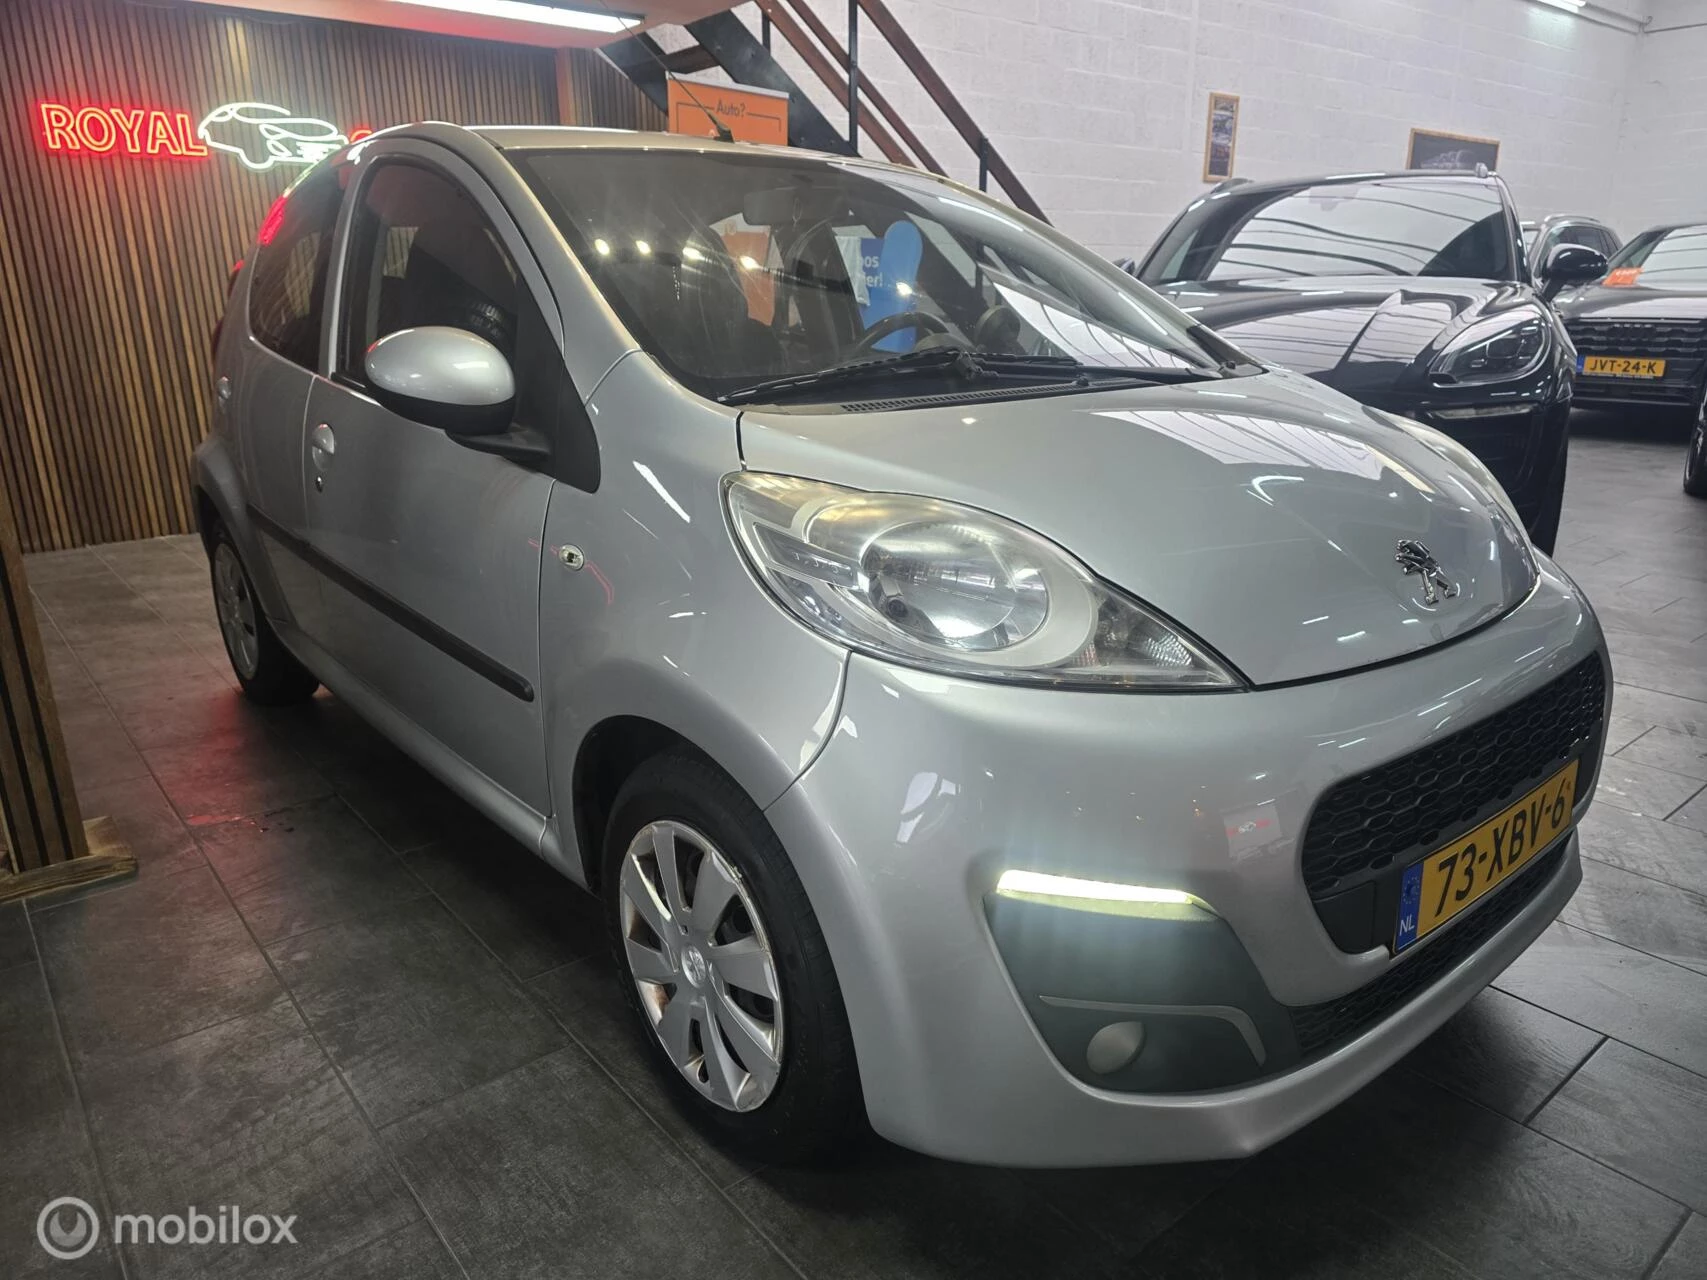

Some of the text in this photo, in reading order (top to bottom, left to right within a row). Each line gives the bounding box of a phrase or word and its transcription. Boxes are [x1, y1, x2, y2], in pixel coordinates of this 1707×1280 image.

[716, 98, 746, 118] Auto?
[41, 103, 208, 156] ROYAL
[861, 255, 880, 269] os
[865, 271, 884, 288] er!
[1589, 359, 1657, 374] JVT-24-K
[1434, 777, 1567, 918] 73-XBV-6
[1399, 913, 1416, 937] NL
